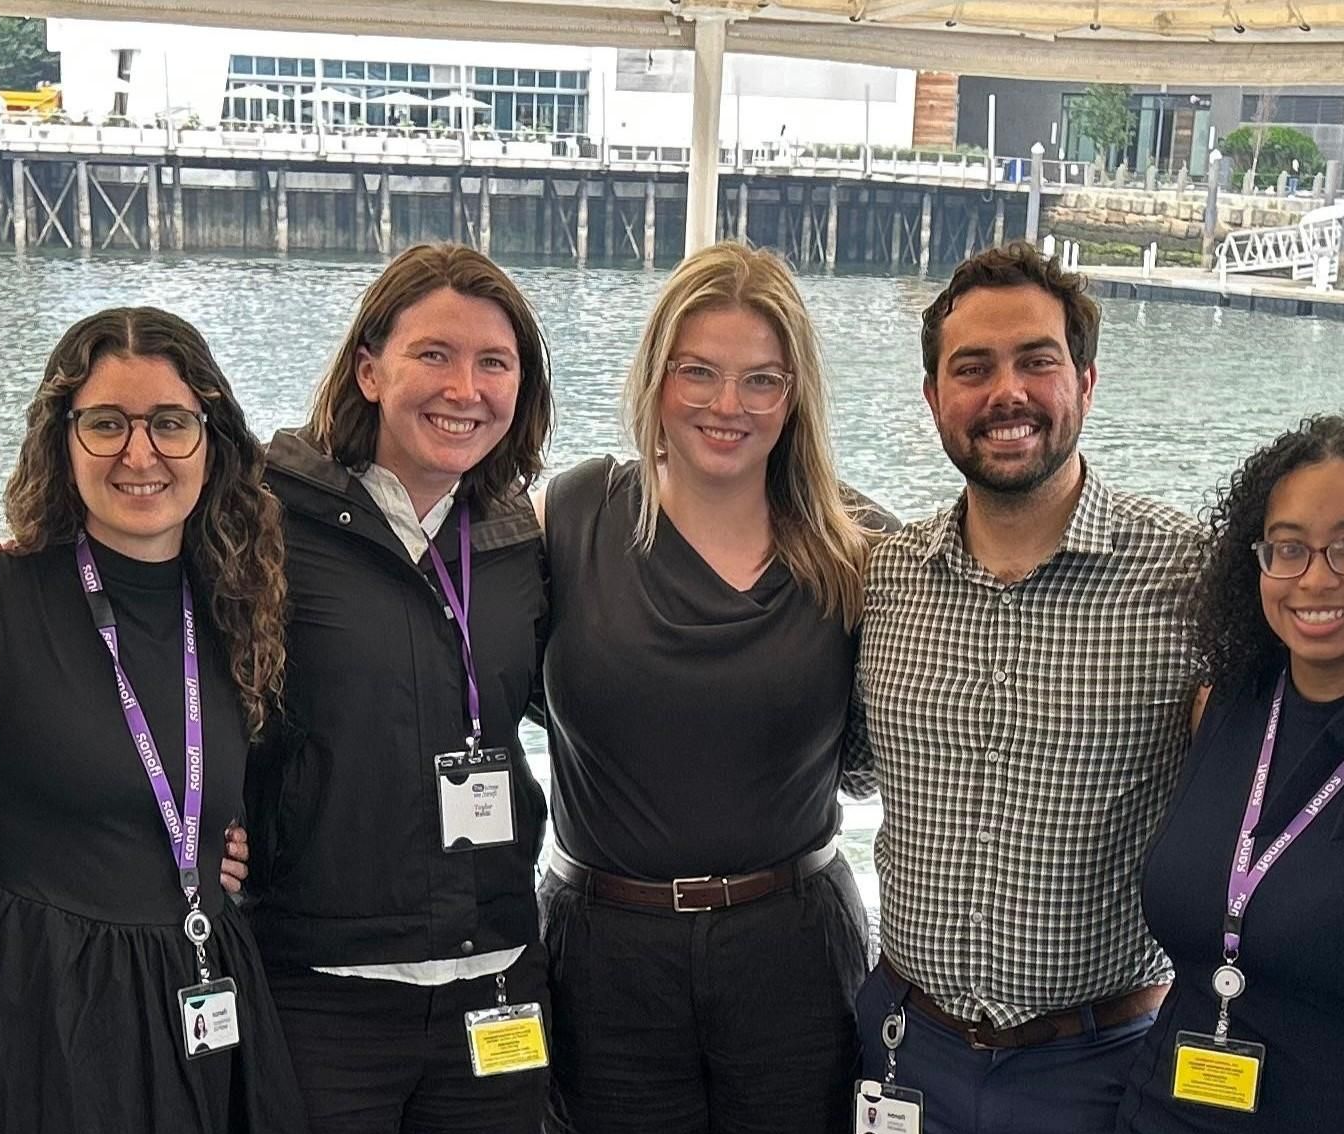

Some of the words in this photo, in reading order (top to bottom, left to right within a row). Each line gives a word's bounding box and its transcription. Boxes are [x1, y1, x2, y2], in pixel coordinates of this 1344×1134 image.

[184, 608, 196, 654] sanofi
[186, 677, 199, 722] sanofi
[136, 732, 163, 777] sanofi
[187, 745, 200, 791] sanofi
[1252, 762, 1268, 807] sanofi
[1305, 775, 1342, 816] sanofi
[162, 800, 183, 844] sanofi
[184, 816, 197, 861] sanofi
[1257, 832, 1292, 873] sanofi
